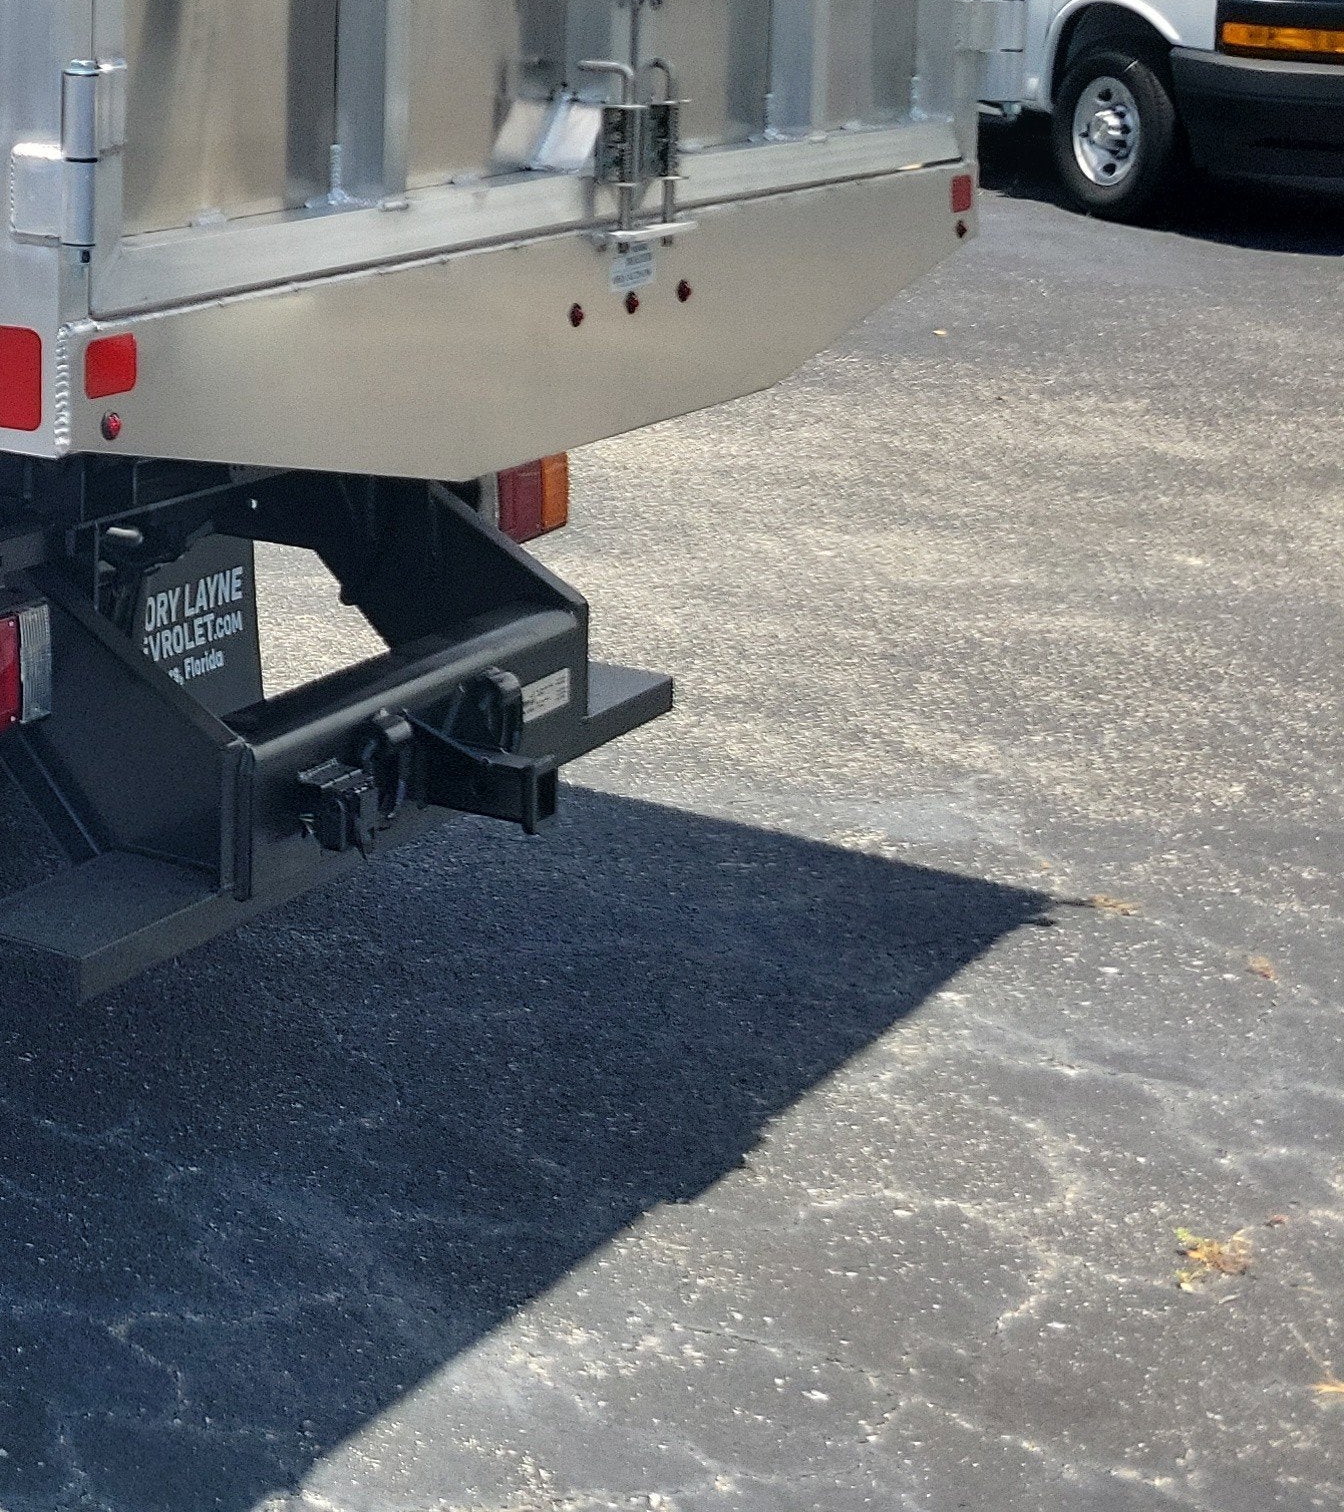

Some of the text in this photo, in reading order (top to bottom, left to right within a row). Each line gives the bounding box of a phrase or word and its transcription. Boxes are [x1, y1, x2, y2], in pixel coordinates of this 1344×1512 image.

[184, 566, 243, 617] LAYNE
[142, 610, 243, 662] VROLET.COM
[184, 648, 224, 680] Florida
